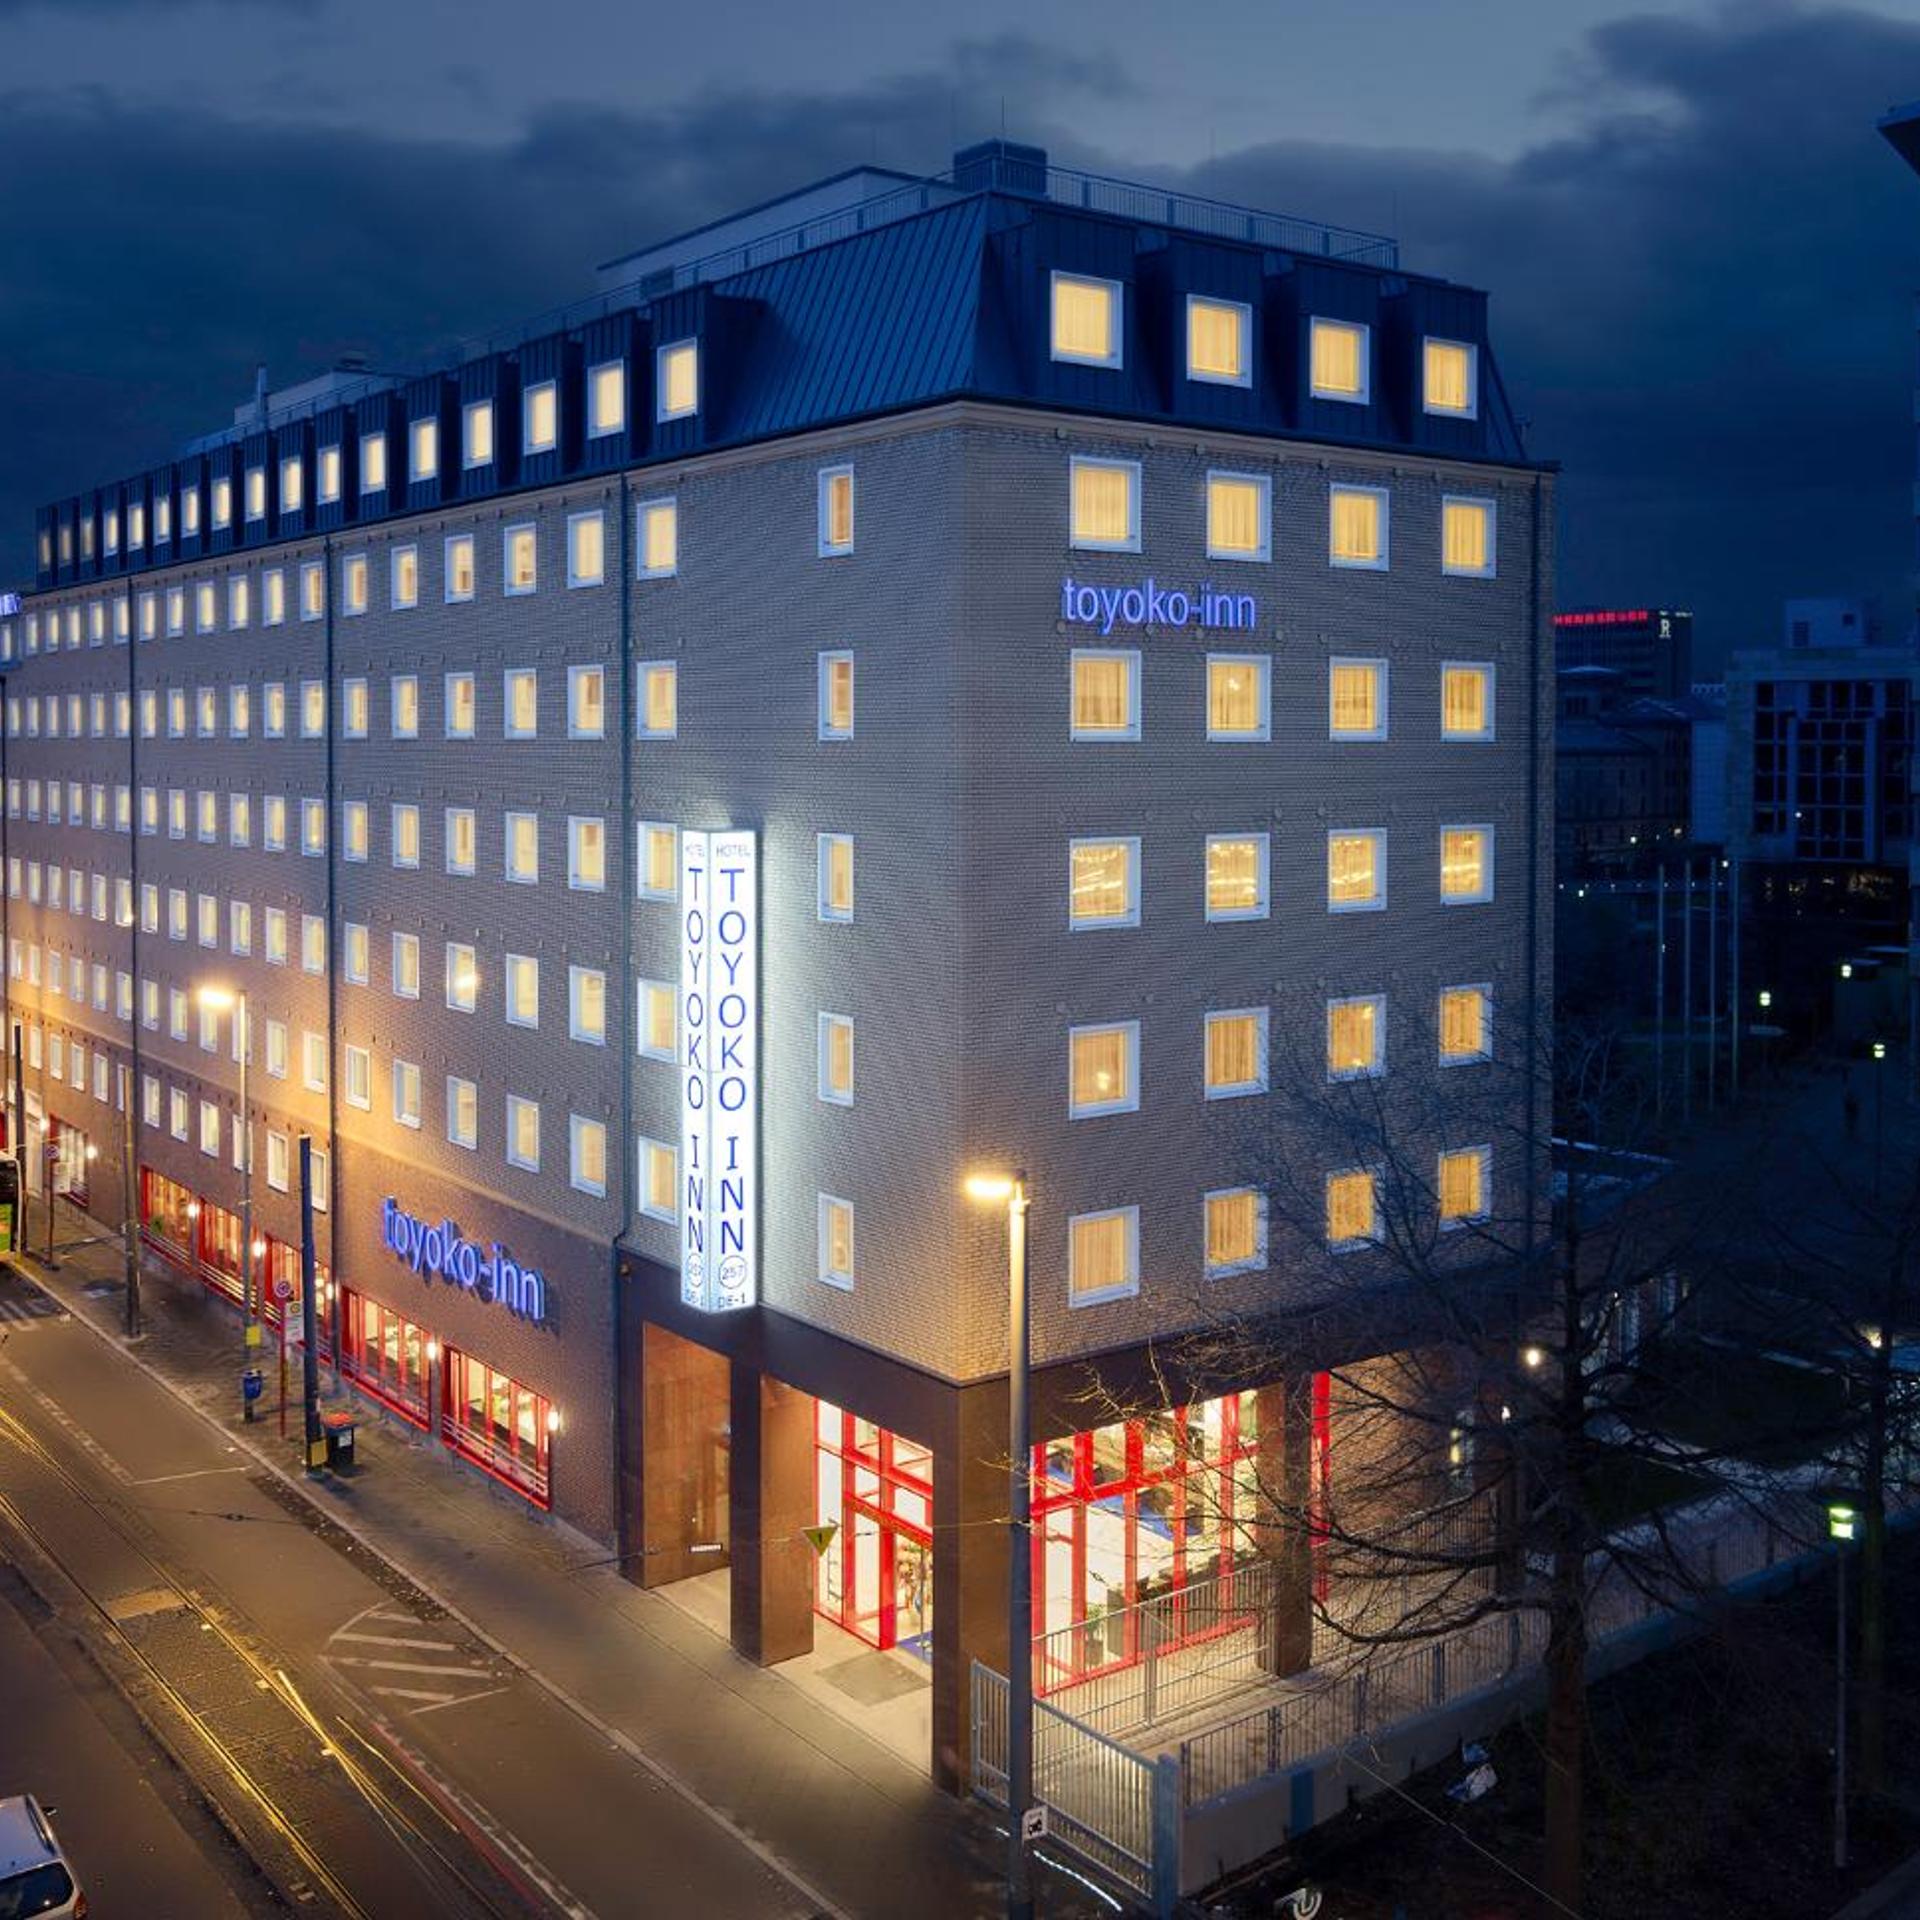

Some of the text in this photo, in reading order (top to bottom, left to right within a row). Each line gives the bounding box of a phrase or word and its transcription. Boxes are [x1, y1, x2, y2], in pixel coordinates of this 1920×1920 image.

[1062, 578, 1257, 636] toyoko-inn
[686, 867, 704, 1110] TOYOKO
[717, 868, 746, 1254] TOYOKO INN
[687, 1135, 704, 1252] INN
[382, 1196, 544, 1320] toyoko-inn
